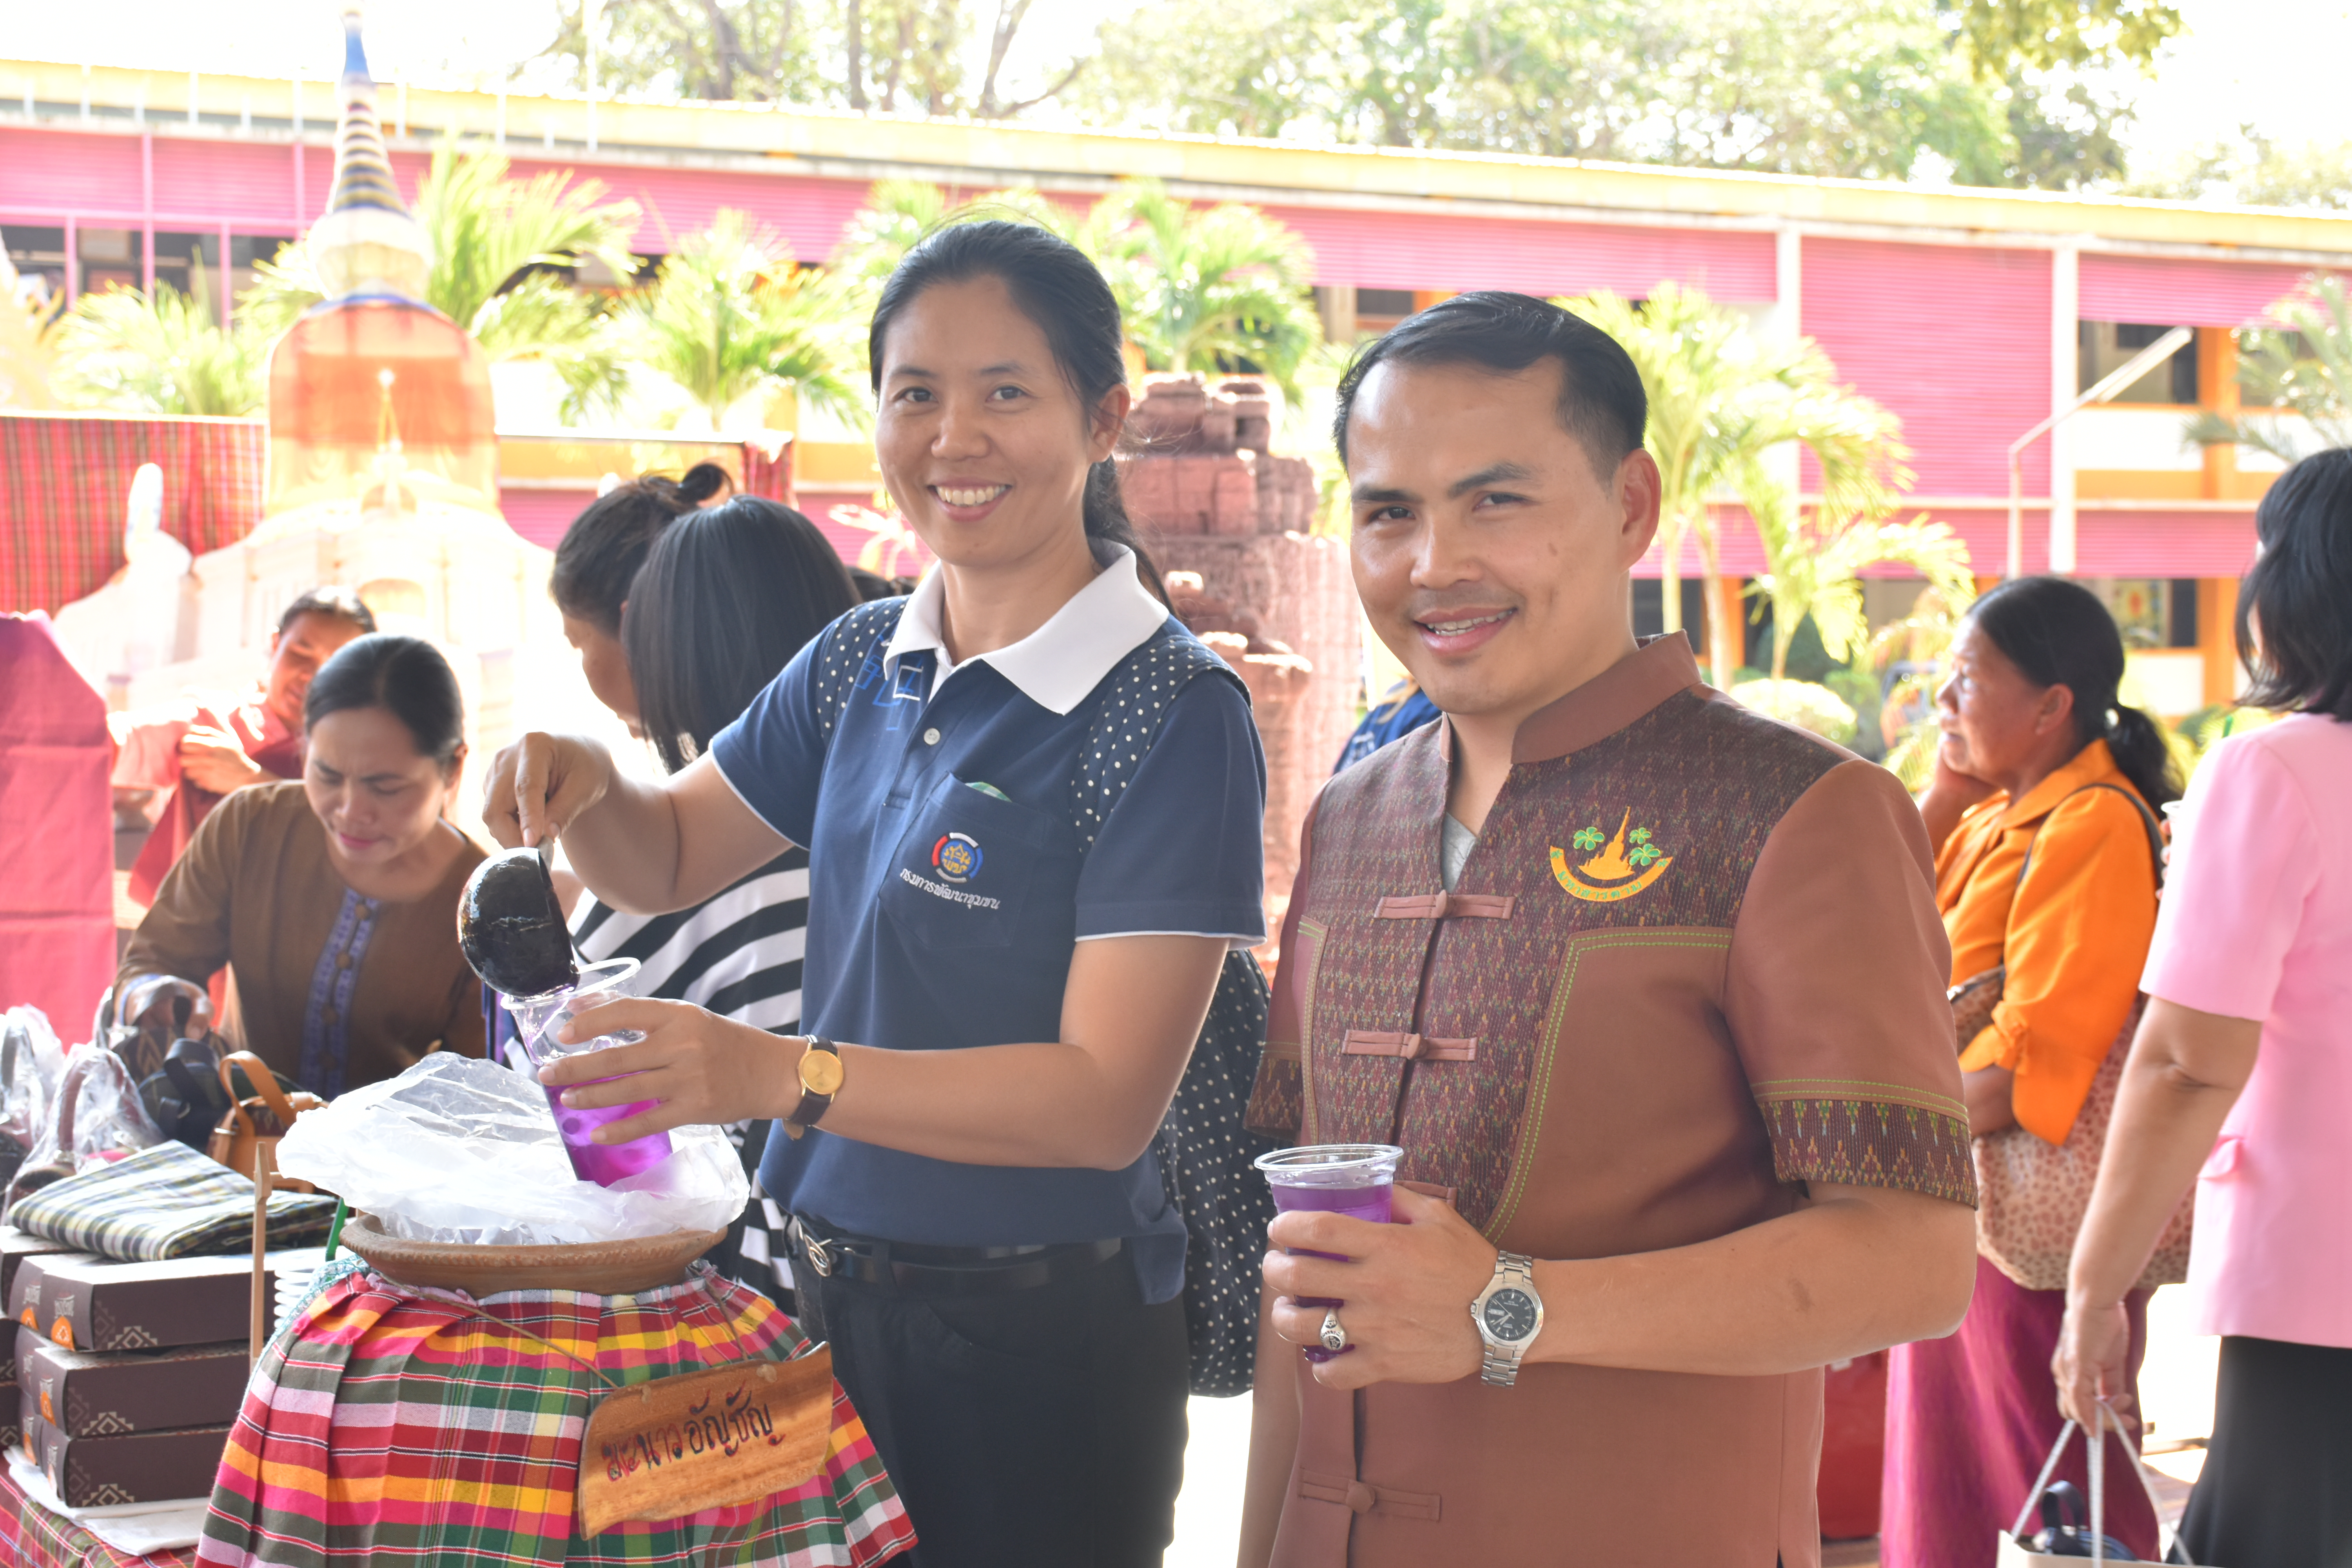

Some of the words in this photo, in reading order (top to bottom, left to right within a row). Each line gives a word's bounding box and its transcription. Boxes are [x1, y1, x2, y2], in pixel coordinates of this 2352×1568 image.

[900, 868, 1001, 909] กรมการพัฒนาชุมชน
[1557, 871, 1642, 900] มหาสารคาม
[601, 1379, 786, 1482] มะนาวอัญชัญ
